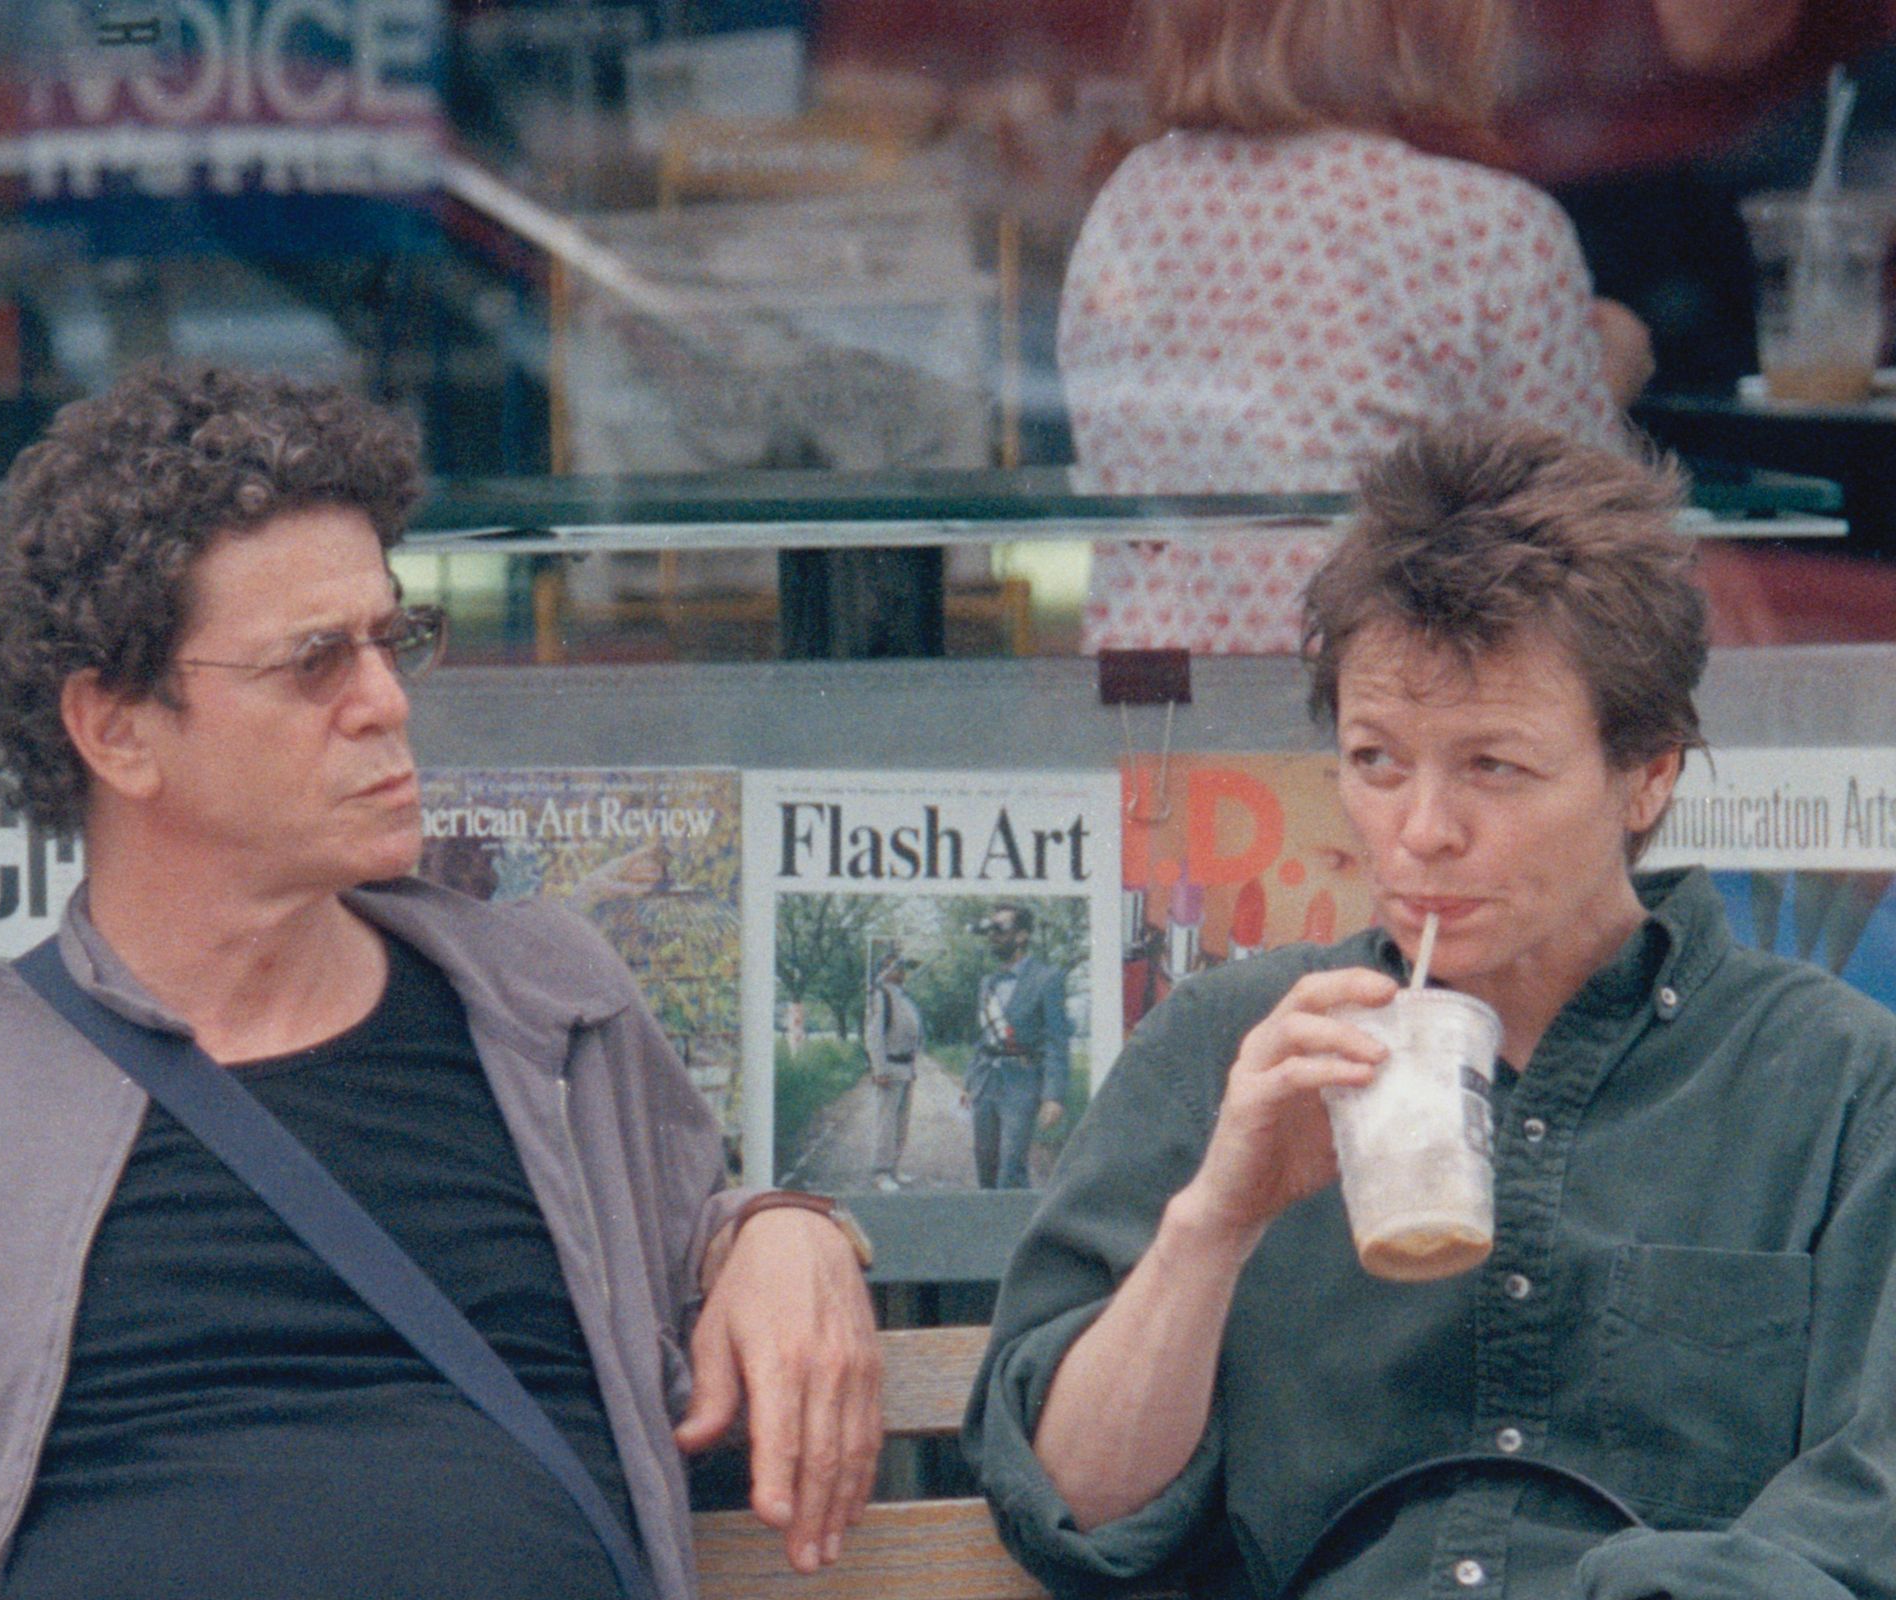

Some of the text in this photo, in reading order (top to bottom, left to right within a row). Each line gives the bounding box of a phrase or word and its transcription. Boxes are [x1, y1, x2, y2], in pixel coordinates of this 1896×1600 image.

[535, 798, 595, 837] Art
[599, 797, 717, 837] Review
[776, 801, 1090, 882] Flash Art
